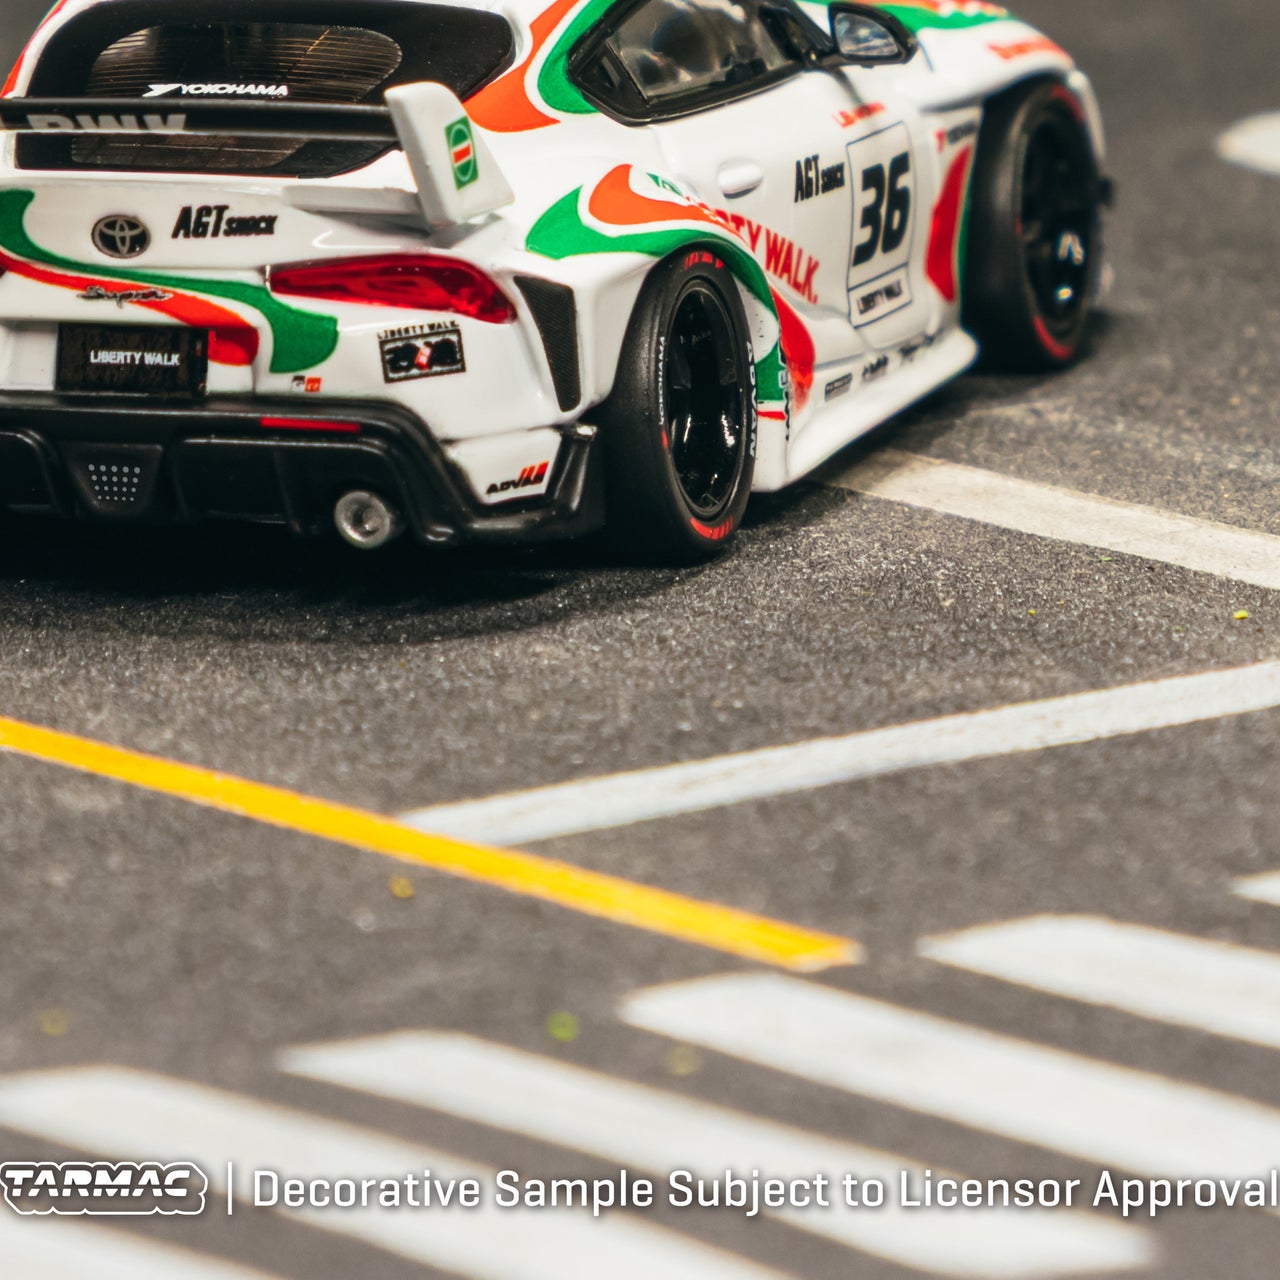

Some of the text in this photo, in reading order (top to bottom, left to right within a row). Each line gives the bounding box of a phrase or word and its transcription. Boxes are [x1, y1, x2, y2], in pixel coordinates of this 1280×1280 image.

[180, 83, 289, 97] YOKOHAMA
[795, 154, 820, 203] AGT
[171, 205, 229, 238] AGT
[852, 151, 910, 267] 36
[90, 349, 180, 366] LIBERTY WALK
